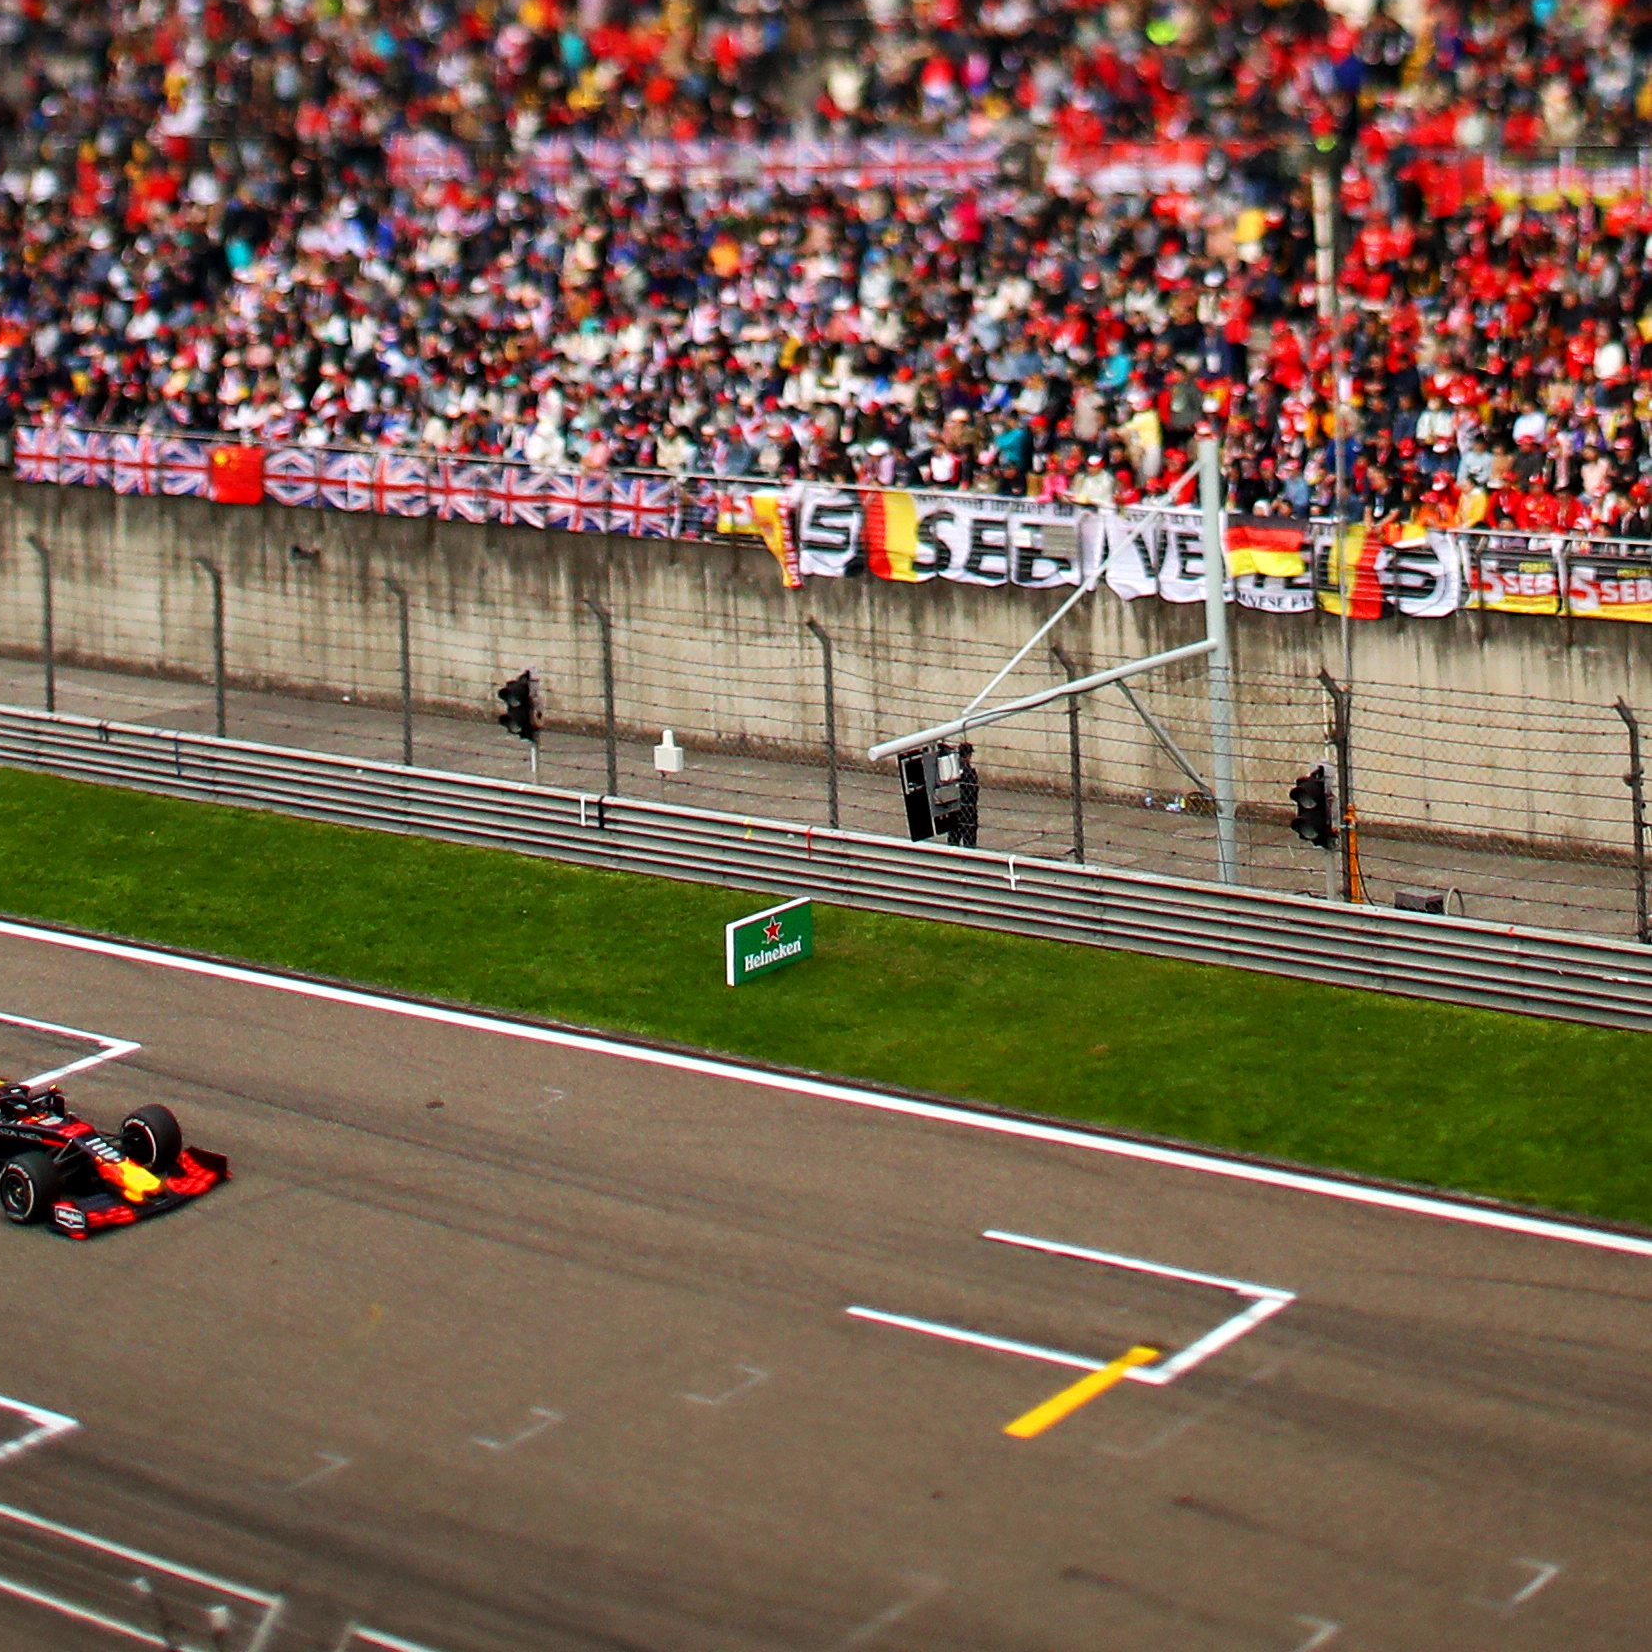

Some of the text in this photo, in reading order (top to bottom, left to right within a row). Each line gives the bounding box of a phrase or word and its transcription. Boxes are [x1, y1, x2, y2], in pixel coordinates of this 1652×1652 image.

[1503, 571, 1557, 595] SEB
[1569, 565, 1600, 611] 5
[744, 939, 802, 973] Heineken
